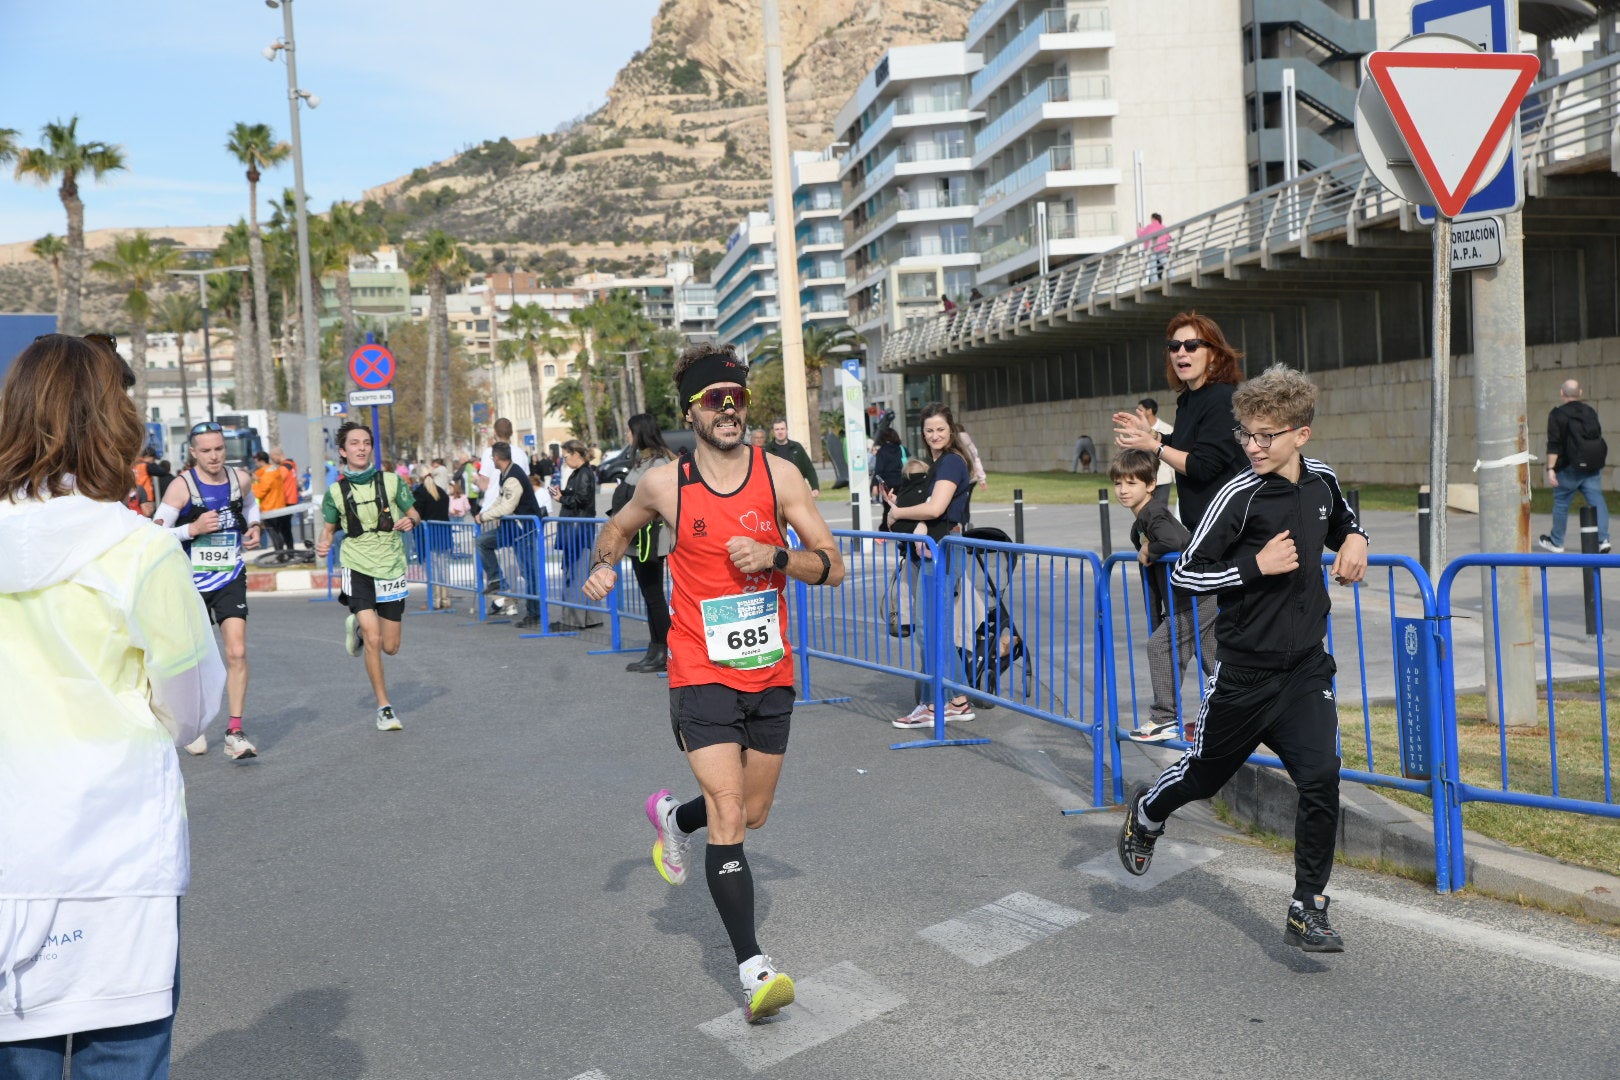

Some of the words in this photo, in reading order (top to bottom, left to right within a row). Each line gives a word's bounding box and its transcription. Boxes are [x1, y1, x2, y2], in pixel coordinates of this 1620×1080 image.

[1453, 246, 1482, 260] A.P.A.
[199, 551, 229, 561] 1894
[382, 580, 406, 592] 1746
[727, 625, 769, 650] 685
[1414, 668, 1419, 684] DE
[1406, 667, 1416, 769] AYUNTAMIENTO
[1414, 695, 1424, 771] ALICANTE
